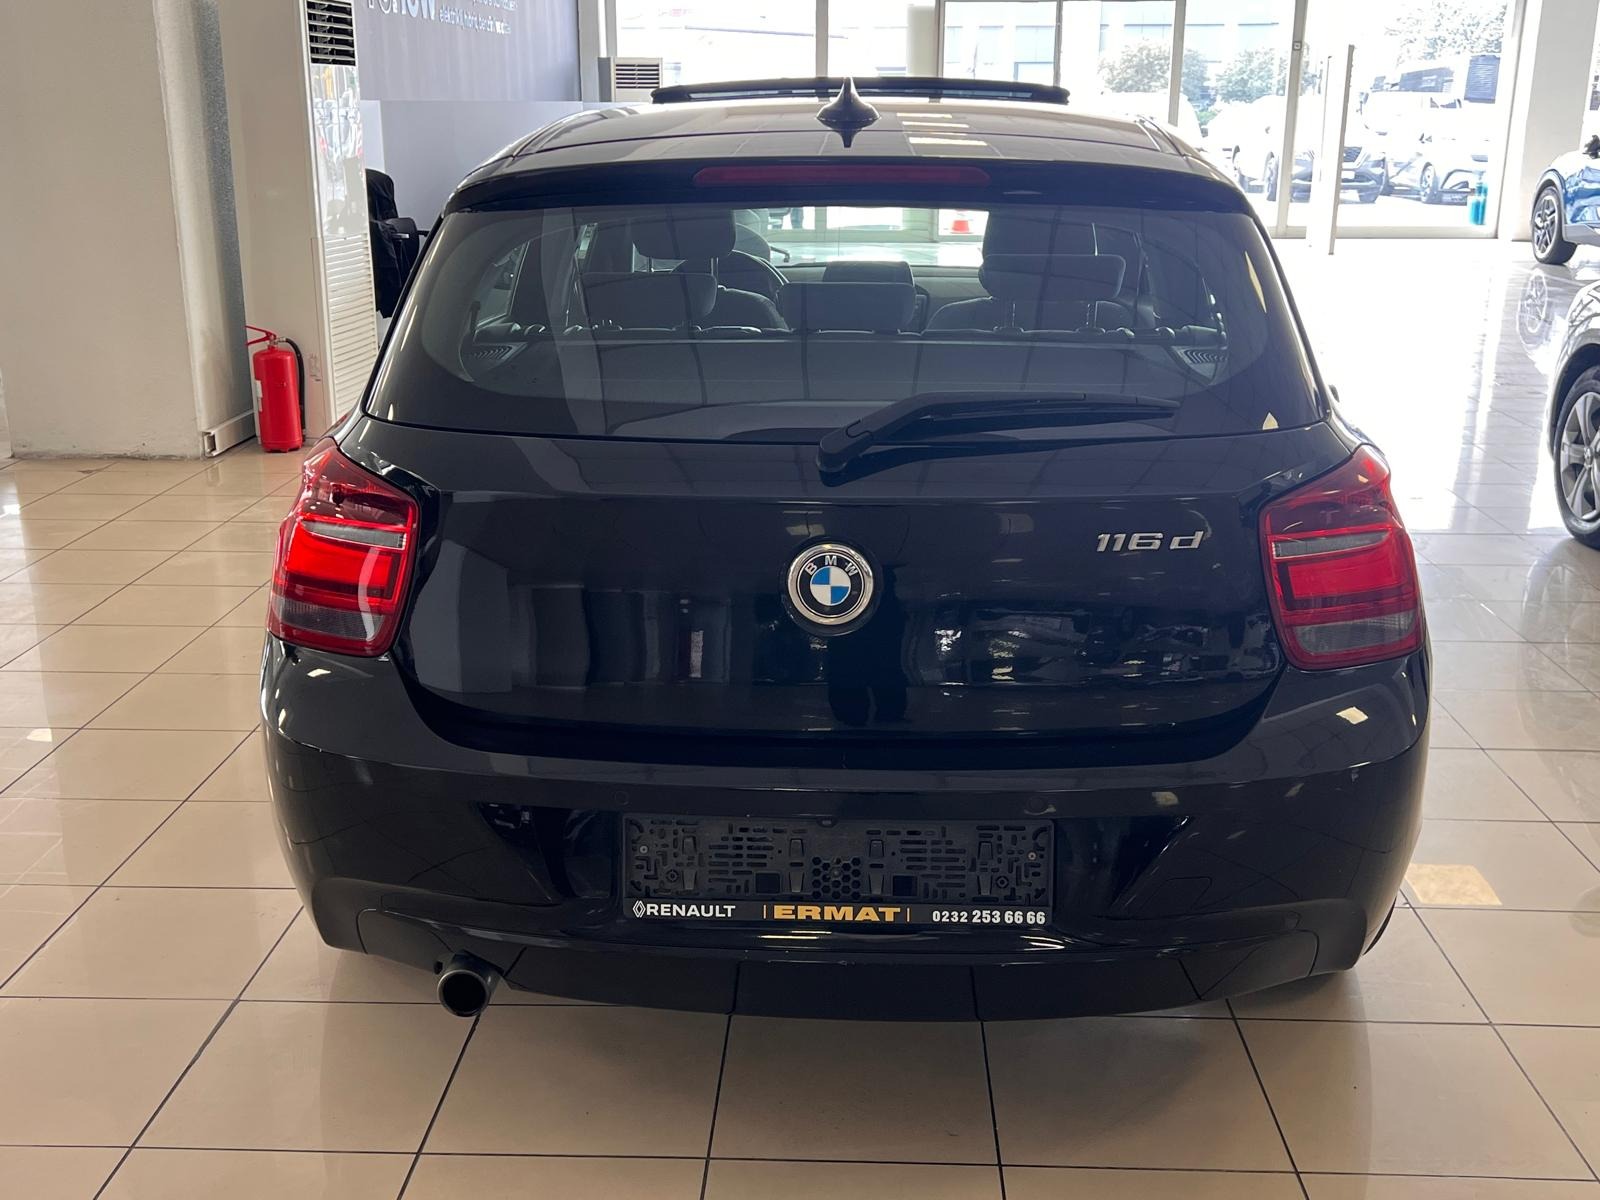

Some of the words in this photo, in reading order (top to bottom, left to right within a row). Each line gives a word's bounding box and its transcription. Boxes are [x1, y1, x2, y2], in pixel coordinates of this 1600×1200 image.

[804, 555, 858, 577] BMW
[646, 903, 736, 918] RENAULT
[773, 904, 901, 922] ERMAT
[932, 910, 968, 923] 0232
[972, 909, 1001, 924] 253
